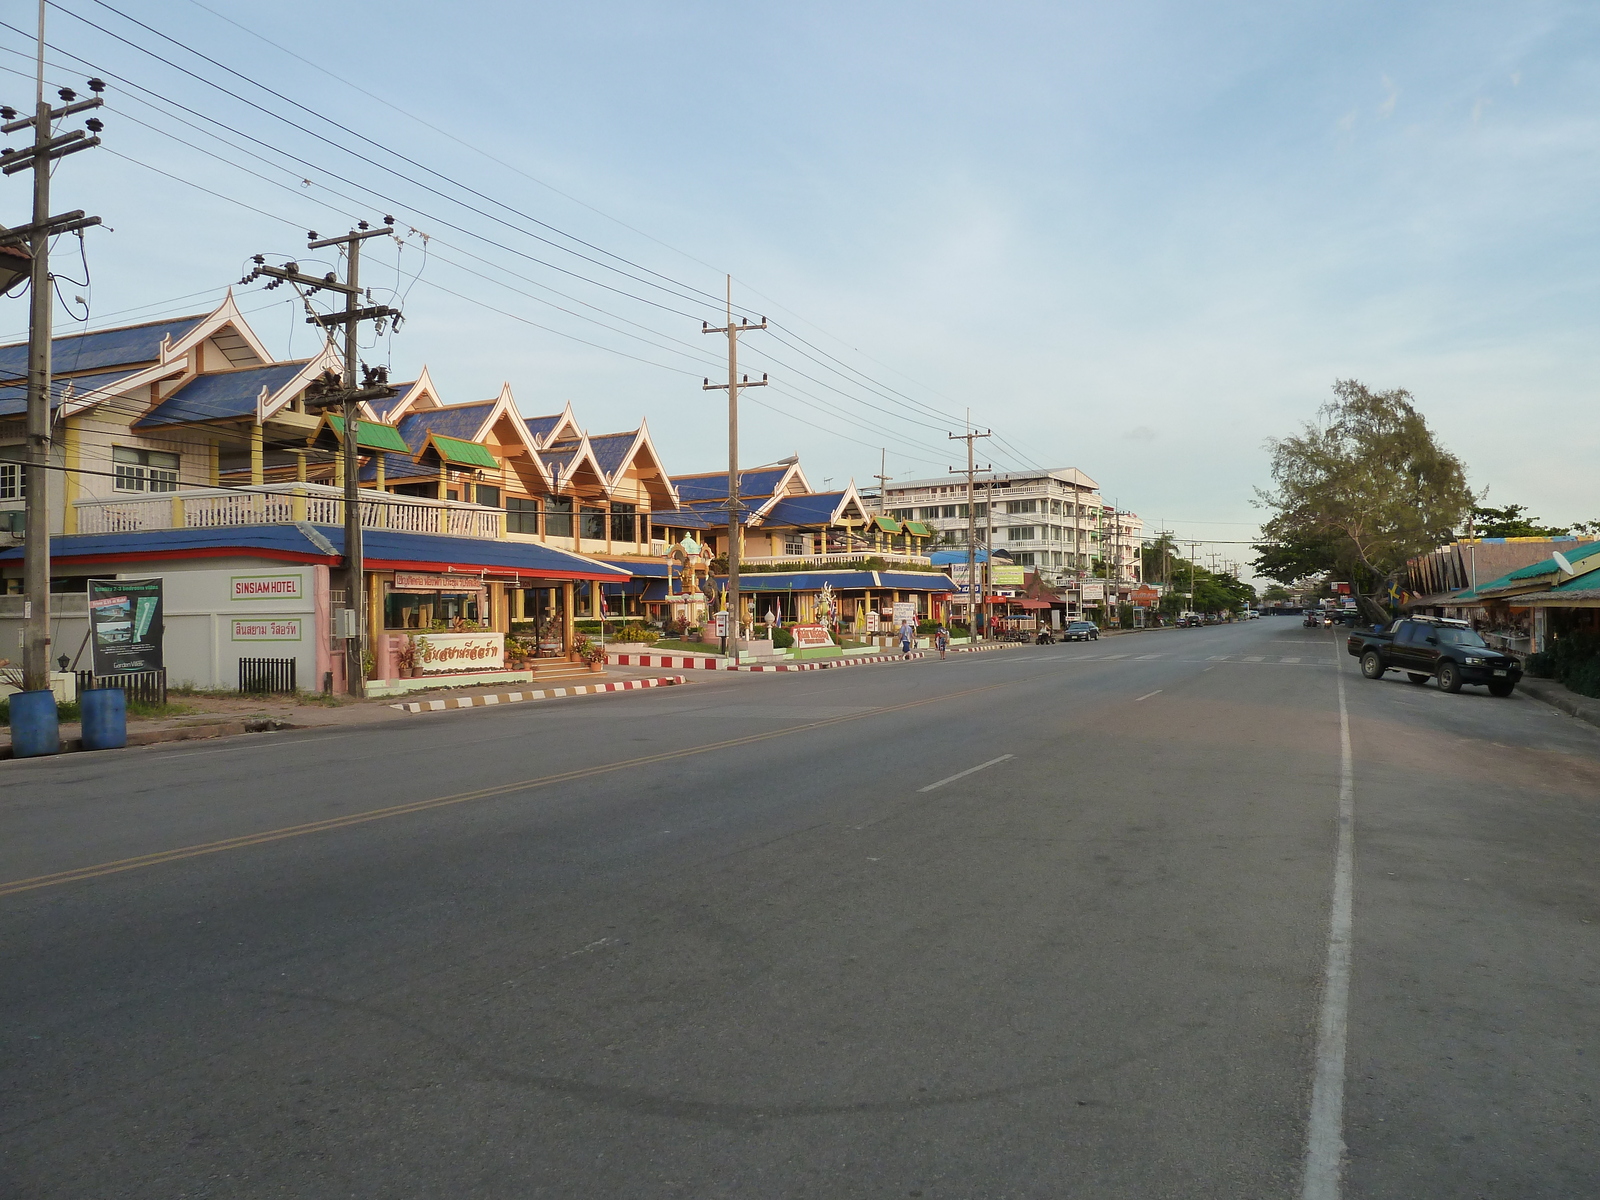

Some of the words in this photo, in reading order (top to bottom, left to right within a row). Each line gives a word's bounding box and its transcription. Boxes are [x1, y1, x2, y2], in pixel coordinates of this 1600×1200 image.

[235, 582, 270, 594] SINSIAM
[271, 581, 296, 593] HOTEL
[235, 622, 267, 635] สินสยาม
[270, 621, 296, 635] รีสอร์ท
